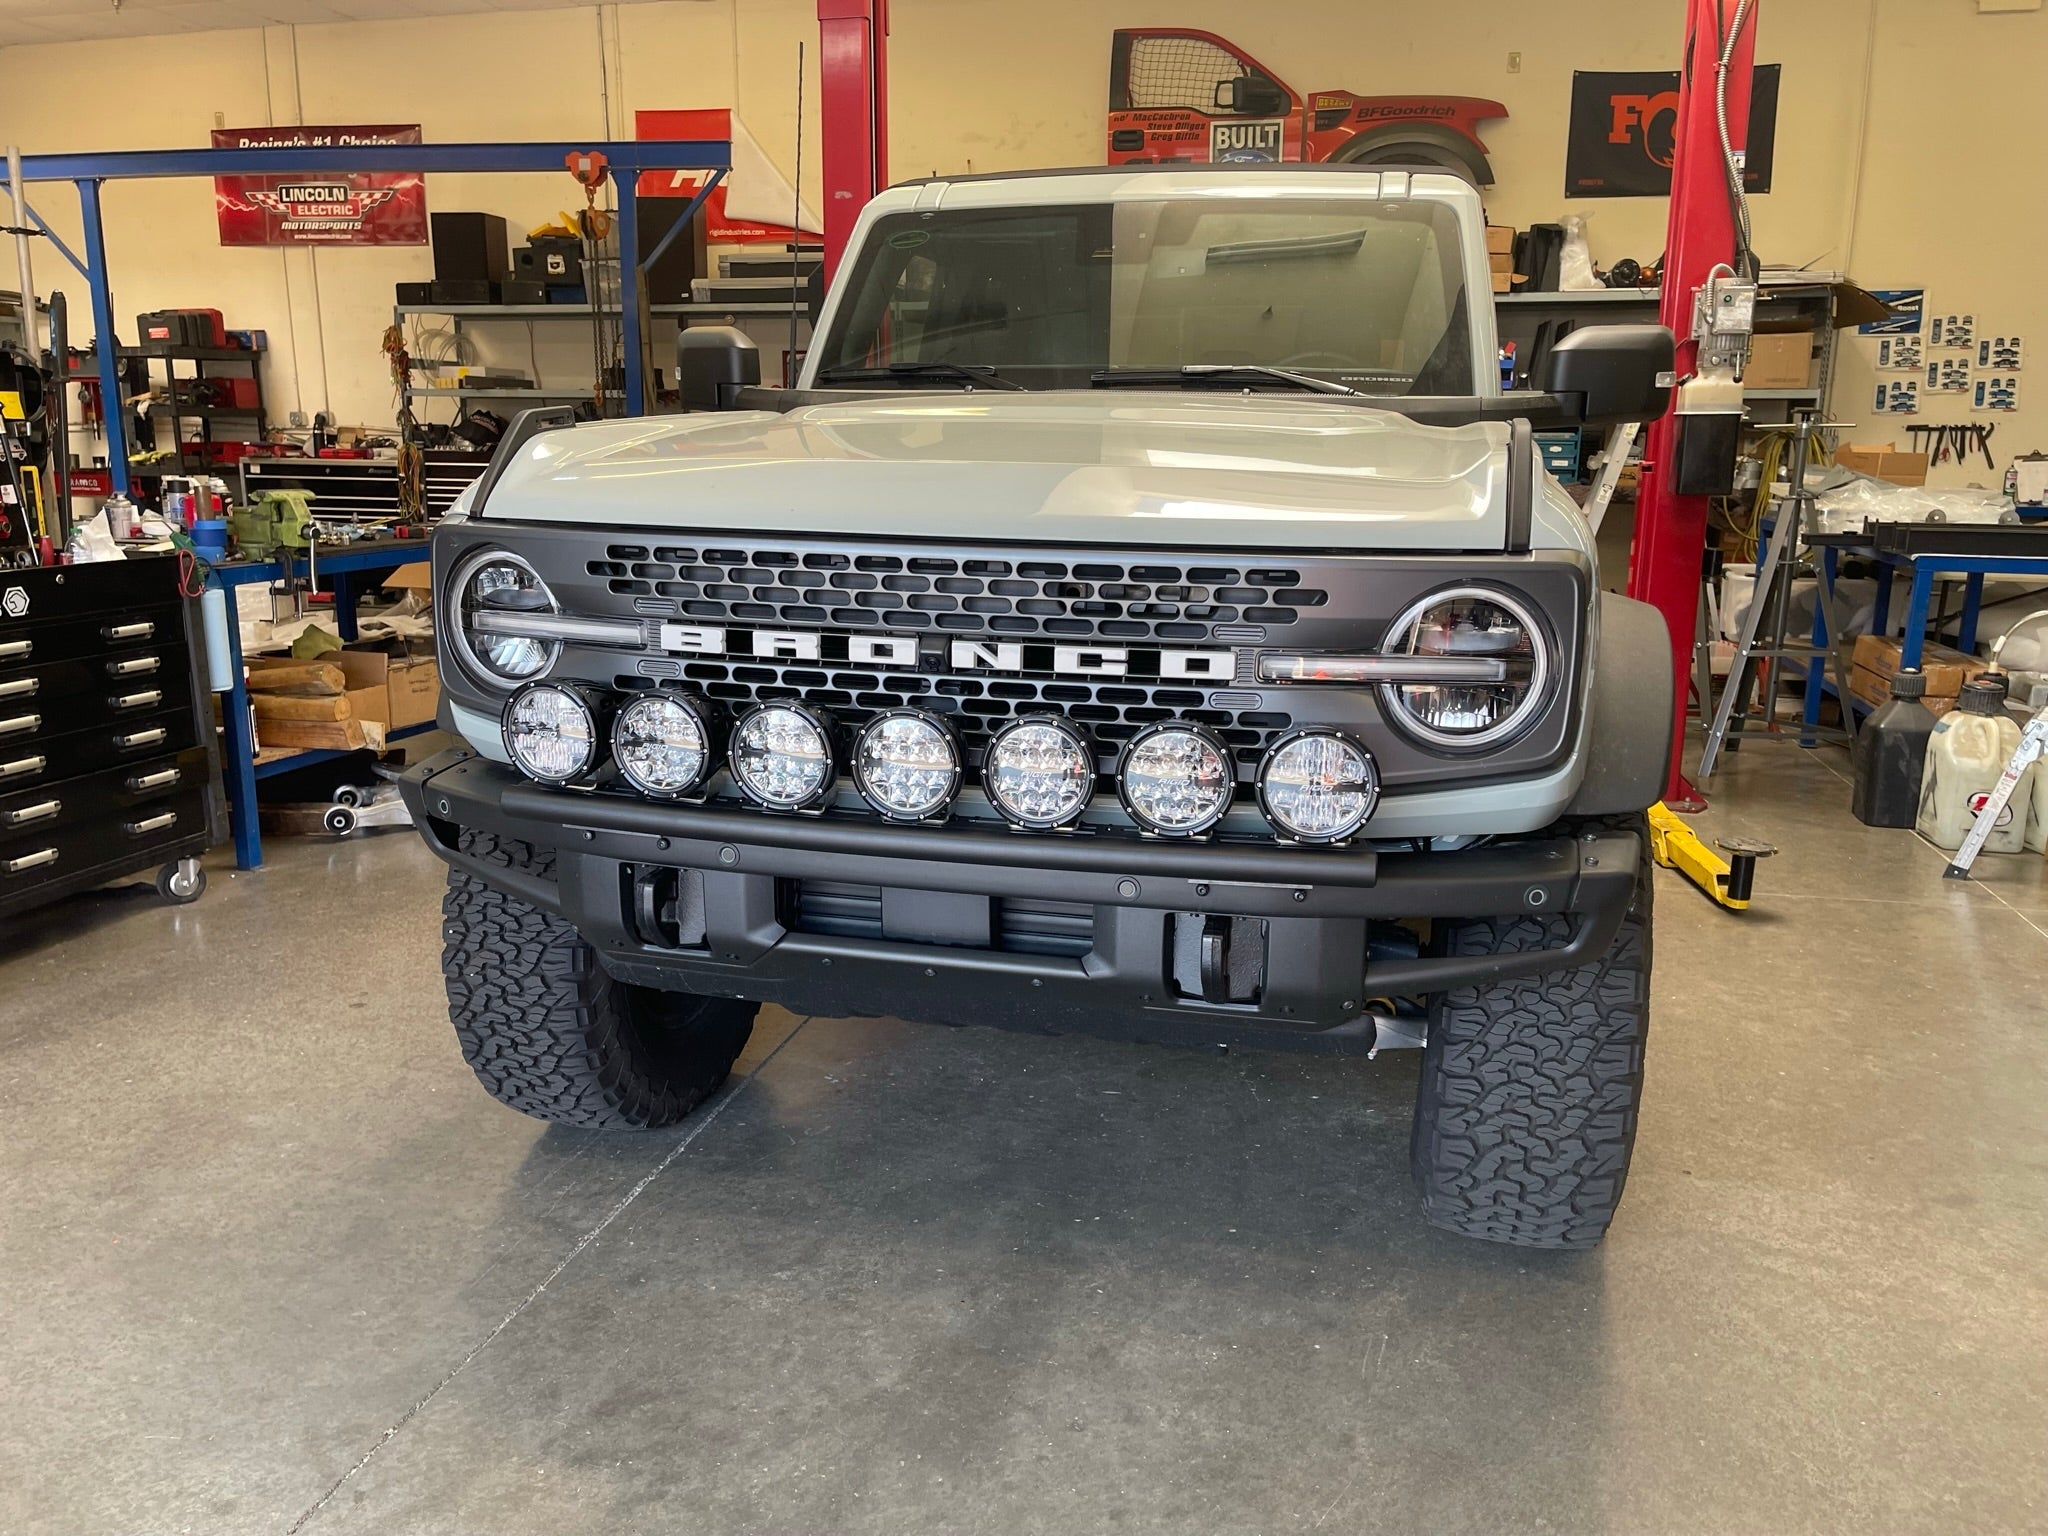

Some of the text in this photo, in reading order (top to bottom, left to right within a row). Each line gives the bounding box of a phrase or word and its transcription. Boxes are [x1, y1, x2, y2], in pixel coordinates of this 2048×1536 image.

[1357, 105, 1456, 119] BFGoodrich
[1147, 122, 1173, 131] Steve
[1216, 125, 1279, 150] BUILT
[281, 187, 345, 202] LINCOLN
[297, 204, 354, 216] ELECTRIC
[281, 221, 362, 230] MOTORSPORTS
[709, 229, 766, 237] rigidindustries.com
[660, 624, 1236, 680] BRONCO
[532, 729, 558, 737] RIGID
[1020, 770, 1052, 779] RIGID
[1158, 777, 1191, 787] RIGID
